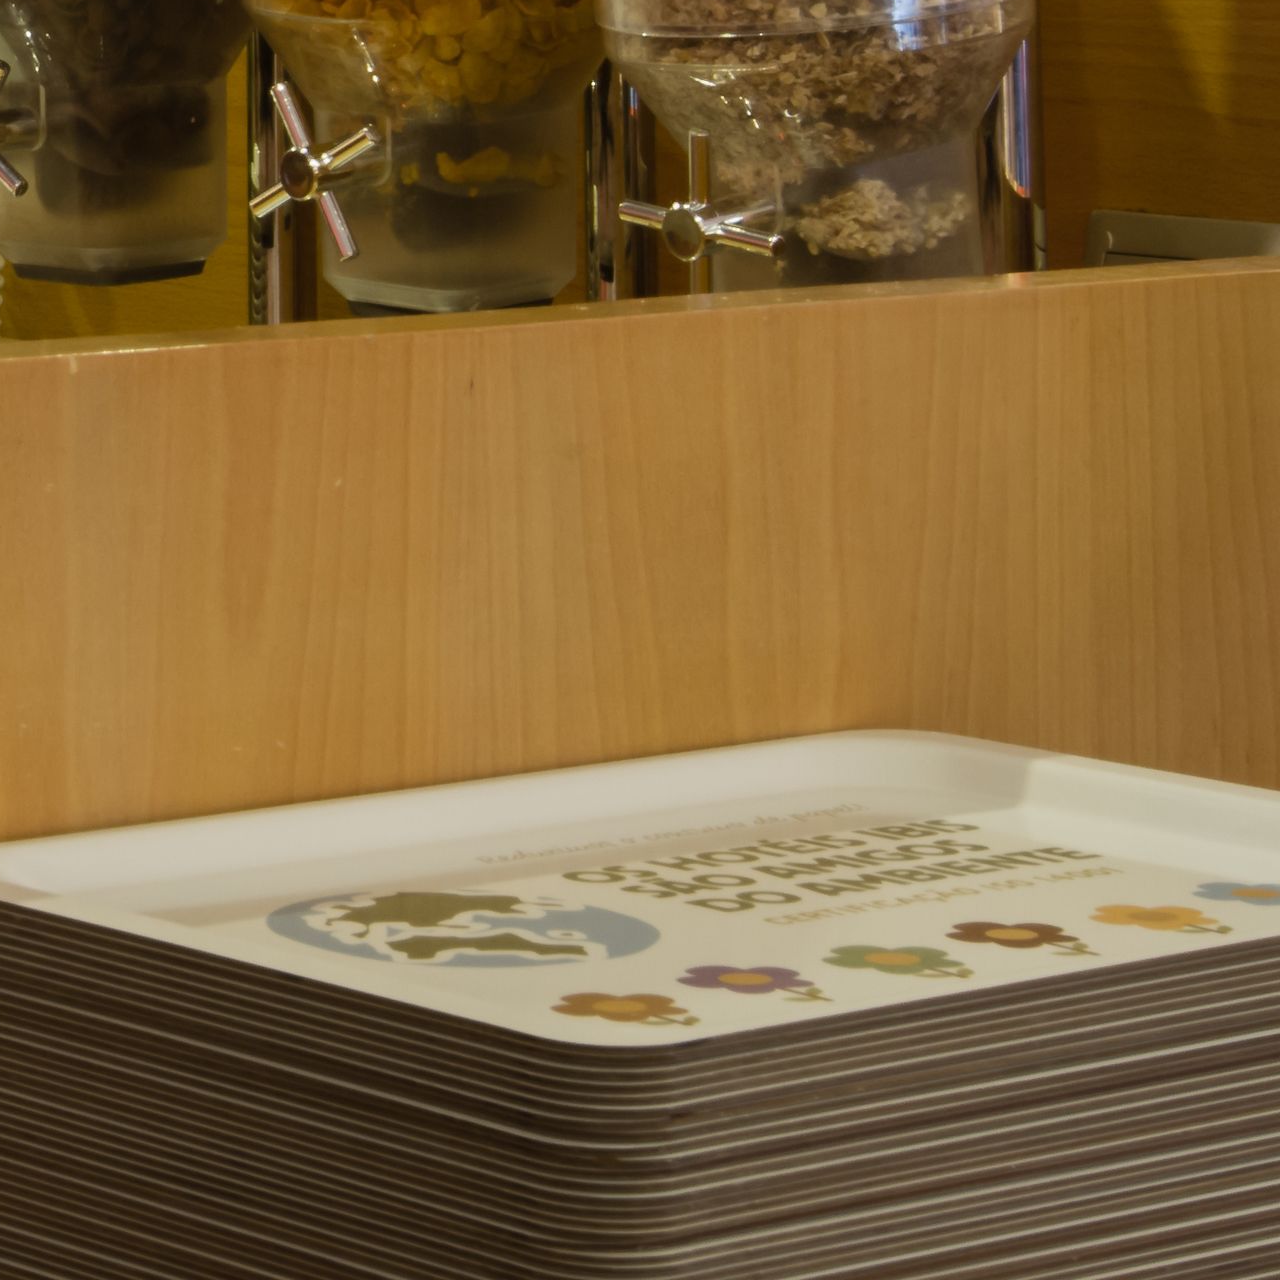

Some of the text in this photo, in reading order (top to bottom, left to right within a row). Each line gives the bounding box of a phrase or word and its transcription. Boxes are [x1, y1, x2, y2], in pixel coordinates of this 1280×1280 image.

[561, 819, 980, 883] OS HOTÉIS IBIS
[620, 839, 990, 898] SÃO AMIGOS
[685, 846, 1103, 912] DO AMBIENTE
